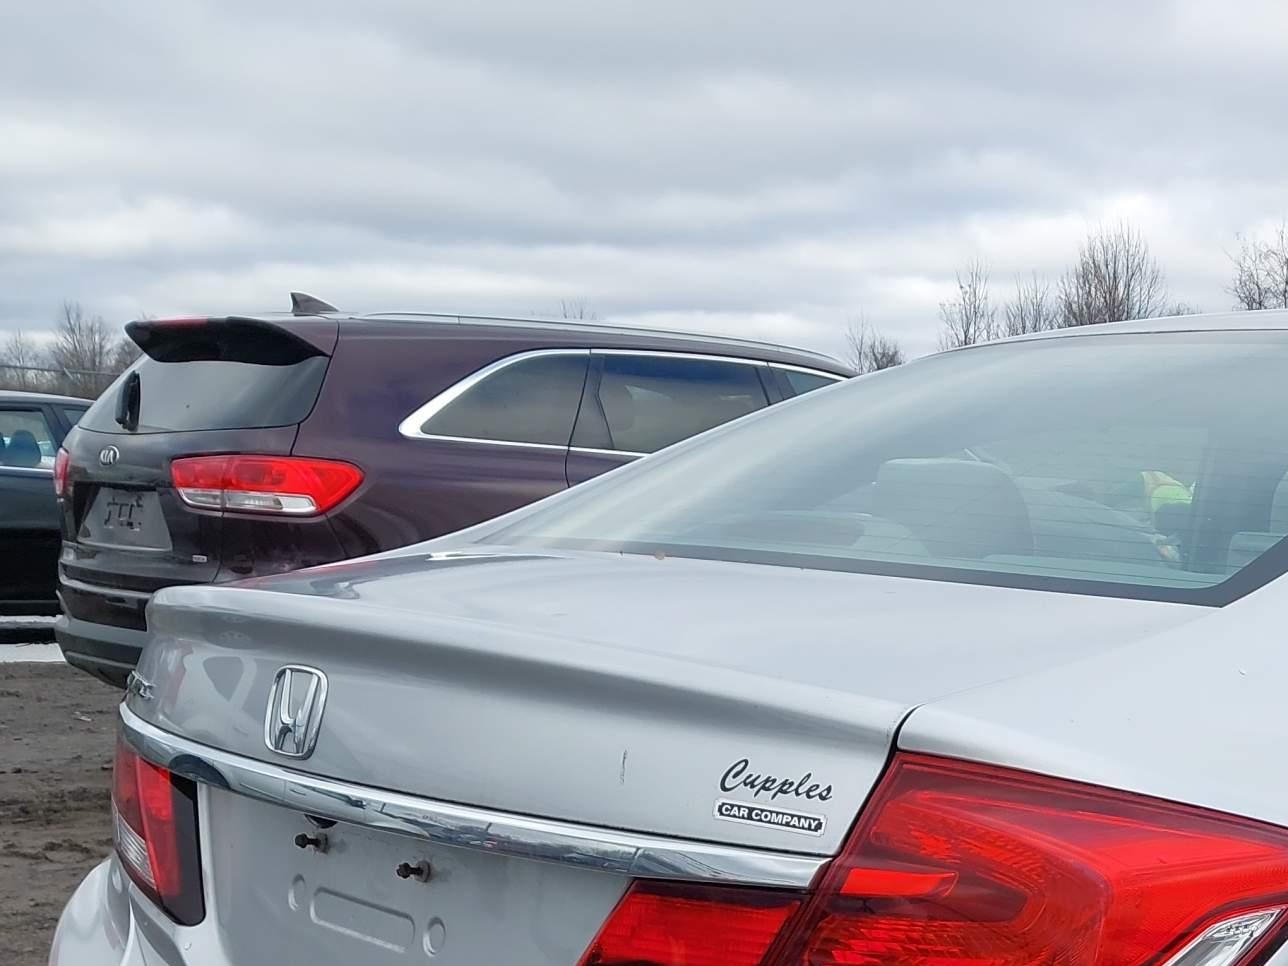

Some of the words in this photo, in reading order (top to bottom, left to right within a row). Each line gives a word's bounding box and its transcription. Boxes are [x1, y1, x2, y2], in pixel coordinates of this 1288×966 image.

[720, 758, 832, 801] Cupples
[721, 804, 749, 818] CAR
[751, 809, 819, 830] COMPANY
